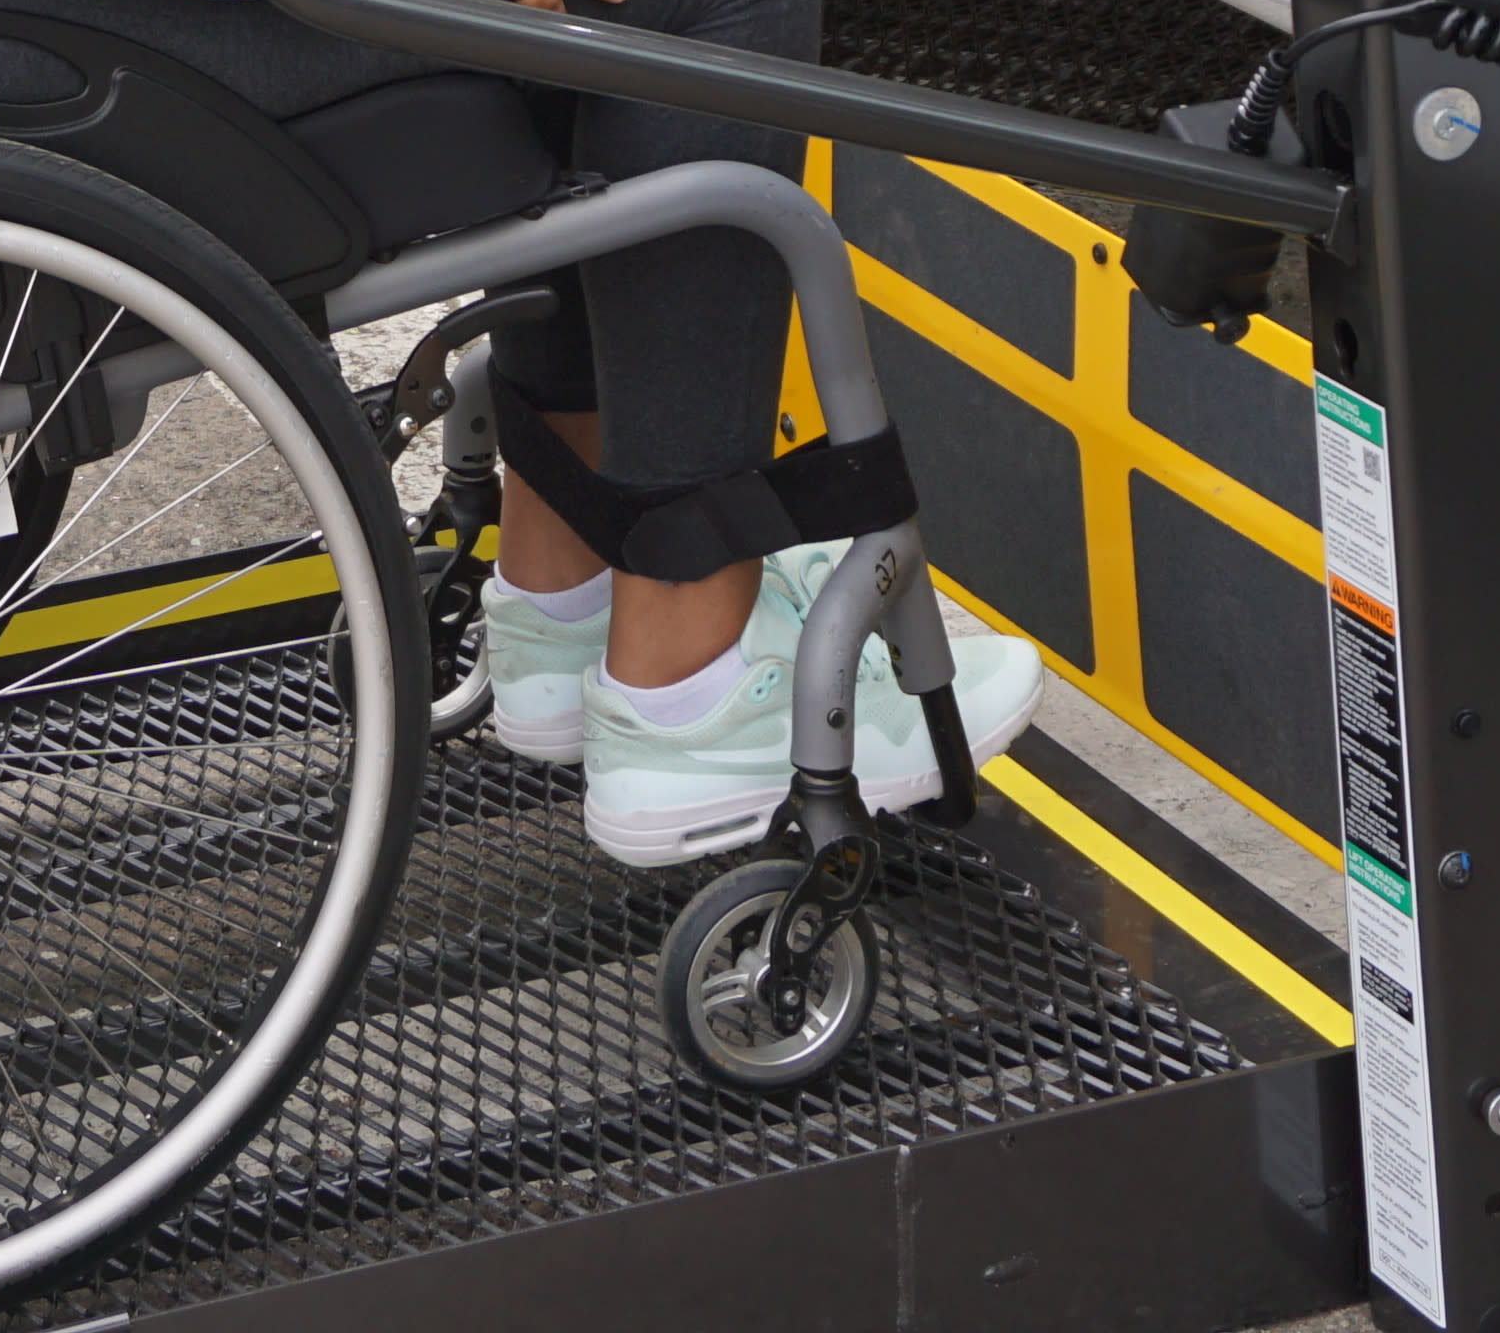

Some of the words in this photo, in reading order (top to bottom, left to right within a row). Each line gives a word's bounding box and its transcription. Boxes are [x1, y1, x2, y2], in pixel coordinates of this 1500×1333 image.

[1341, 587, 1395, 629] WARNING
[1348, 848, 1363, 866] LIFT
[1363, 859, 1406, 896] OPERATING
[1348, 861, 1402, 904] INSTRUCTIONS
